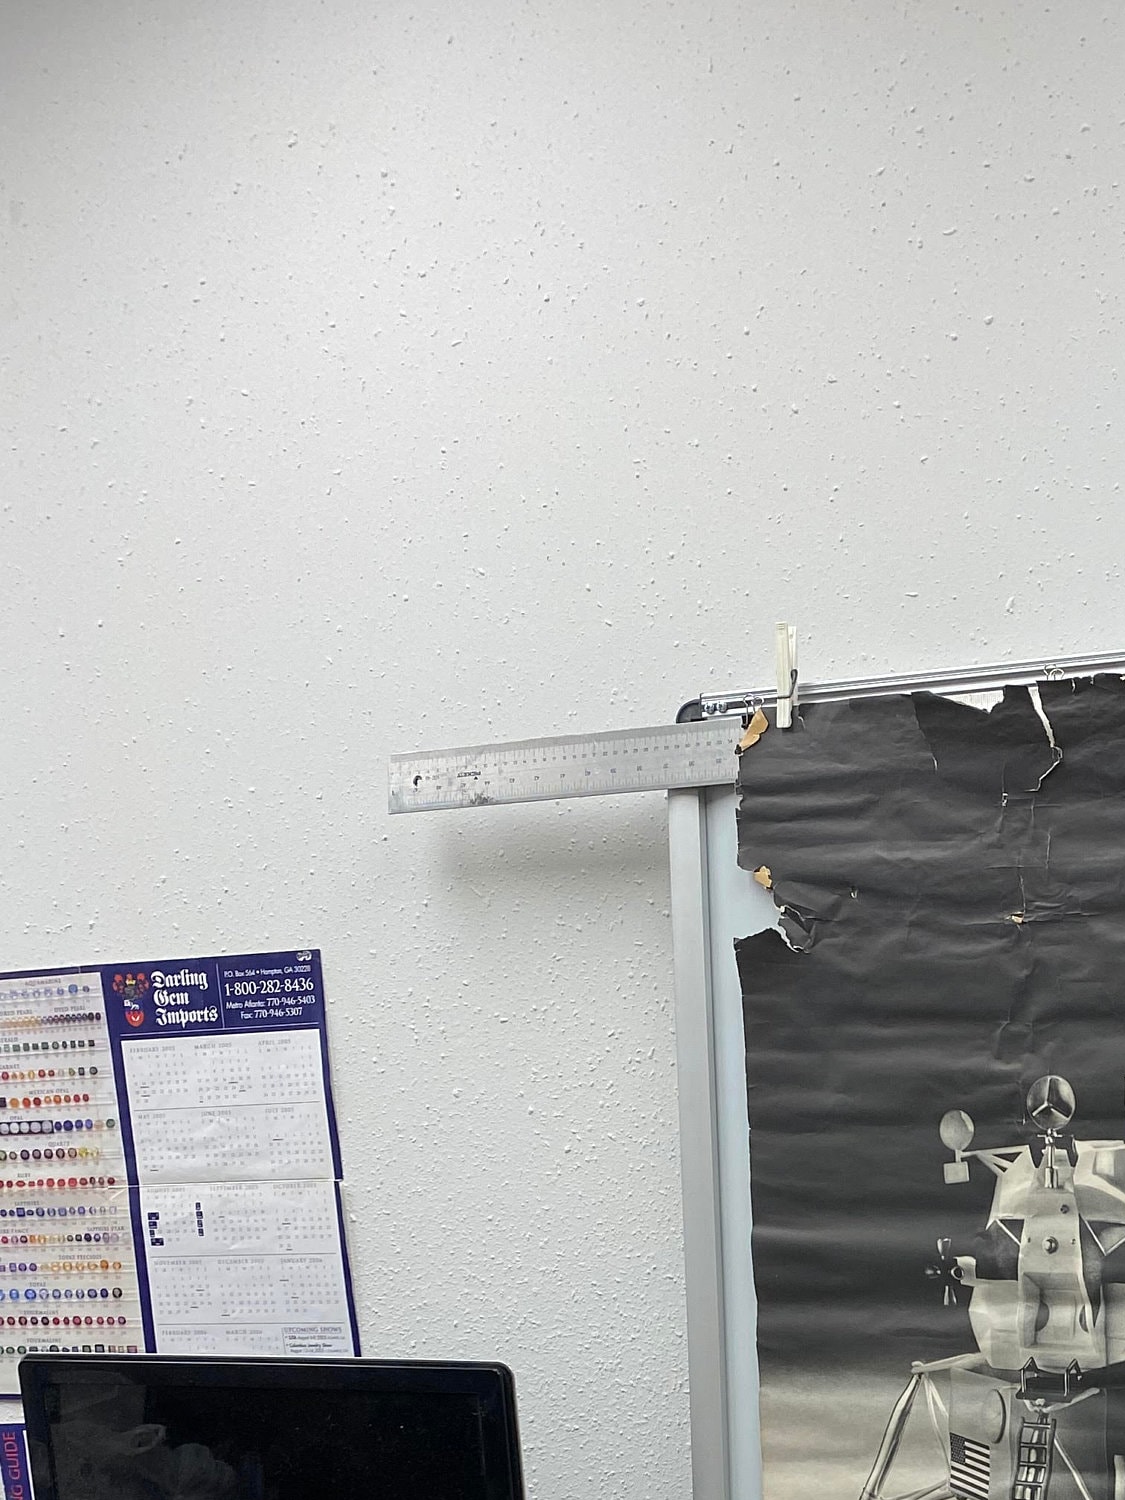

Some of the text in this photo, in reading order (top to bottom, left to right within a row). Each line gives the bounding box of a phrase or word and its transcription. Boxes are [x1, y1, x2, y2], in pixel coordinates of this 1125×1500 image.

[150, 968, 209, 990] Darling
[224, 978, 314, 997] 1-800-282-8436
[153, 991, 190, 1006] Gem
[266, 995, 316, 1007] 770-946-5403
[155, 1006, 219, 1028] Imports
[3, 1431, 21, 1480] GUIDE
